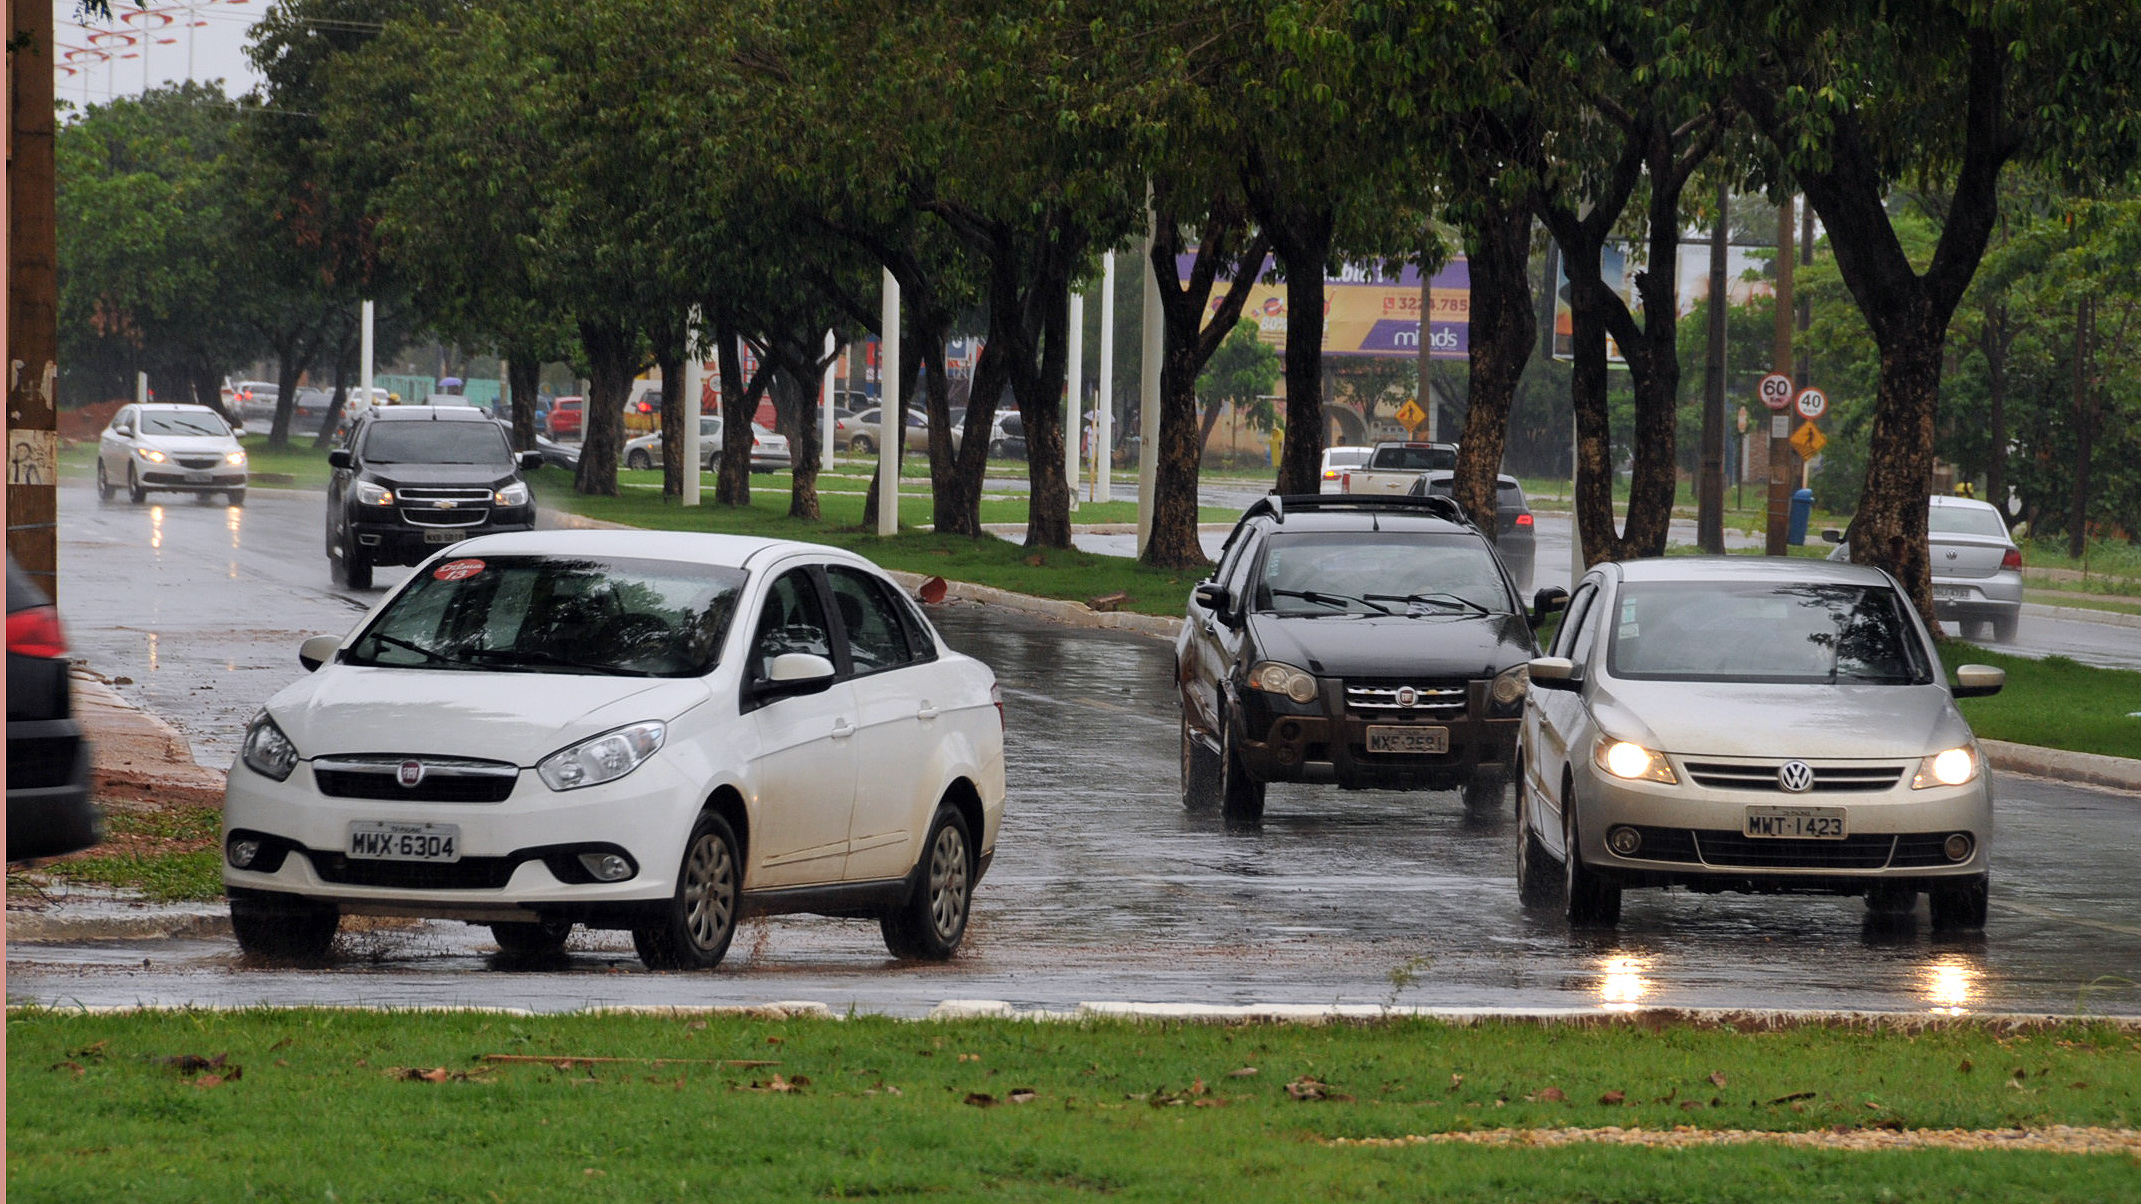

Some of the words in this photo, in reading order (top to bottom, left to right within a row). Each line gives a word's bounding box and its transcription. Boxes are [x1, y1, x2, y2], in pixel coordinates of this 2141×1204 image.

[1763, 380, 1788, 396] 60
[1801, 394, 1821, 408] 40
[444, 569, 469, 581] 13
